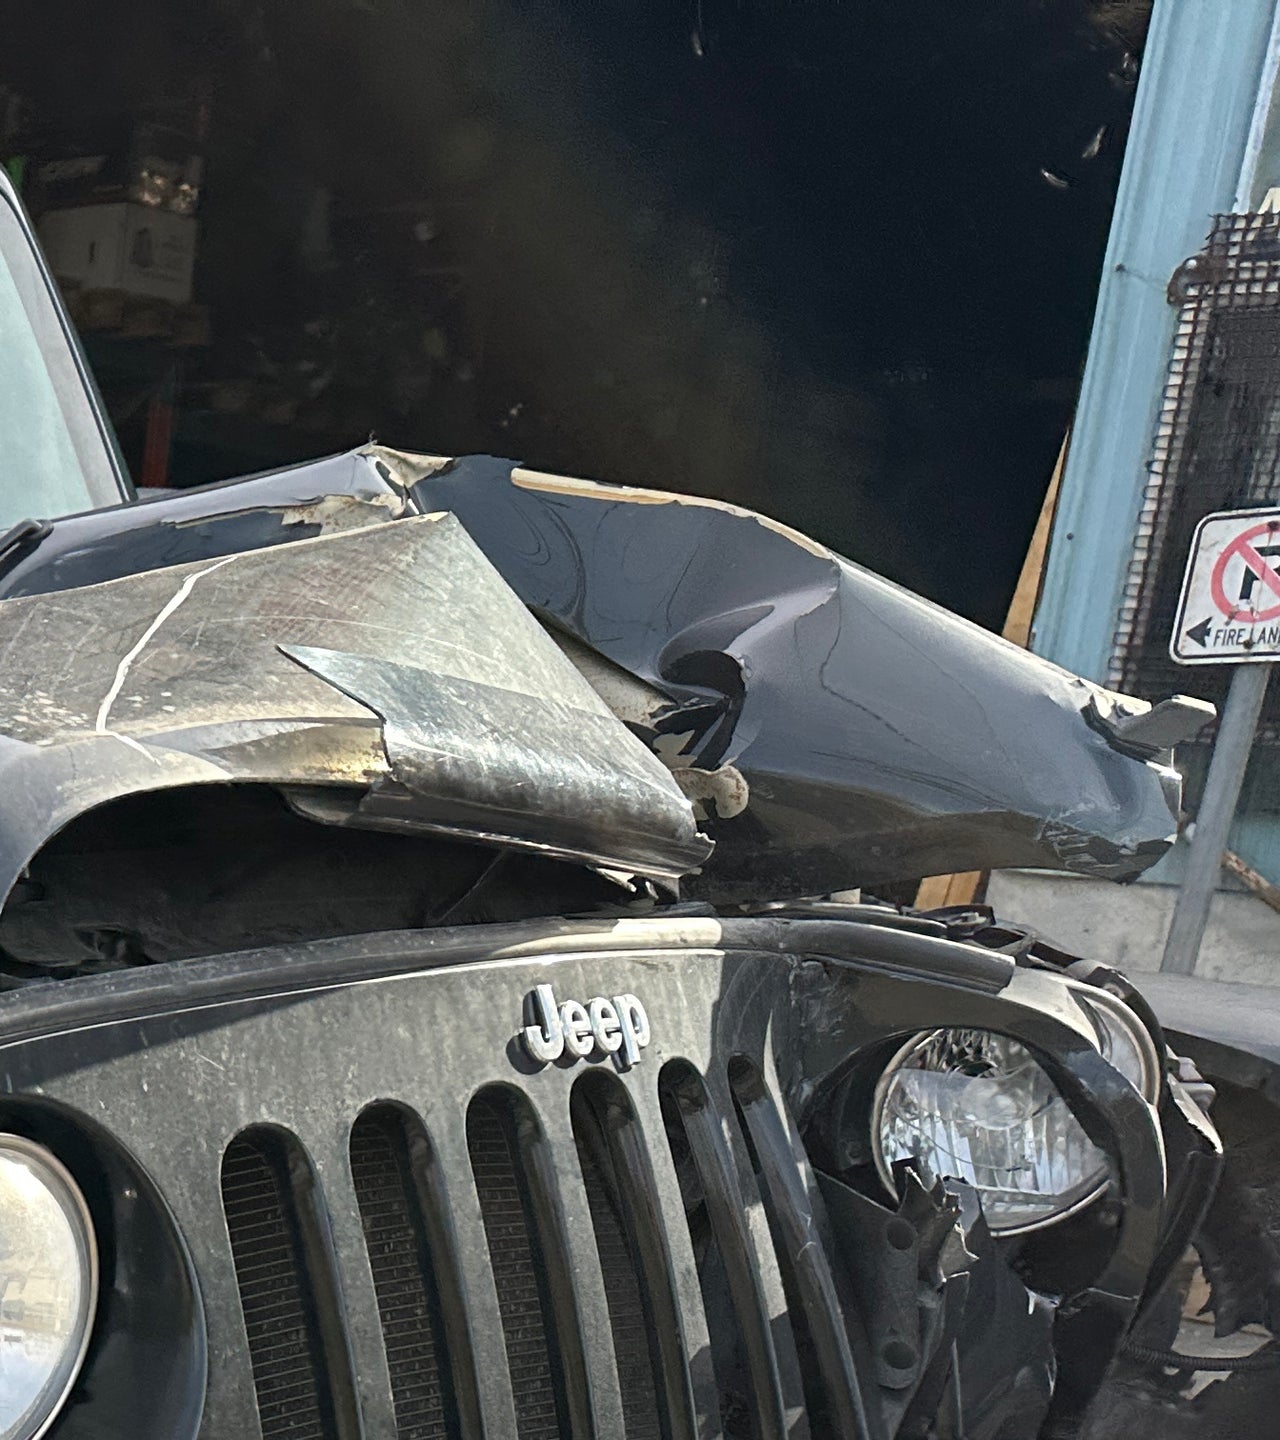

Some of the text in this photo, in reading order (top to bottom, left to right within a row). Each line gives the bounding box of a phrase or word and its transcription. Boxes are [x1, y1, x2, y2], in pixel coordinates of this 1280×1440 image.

[1212, 626, 1280, 647] FIRE LAN
[524, 983, 652, 1066] Jeep
